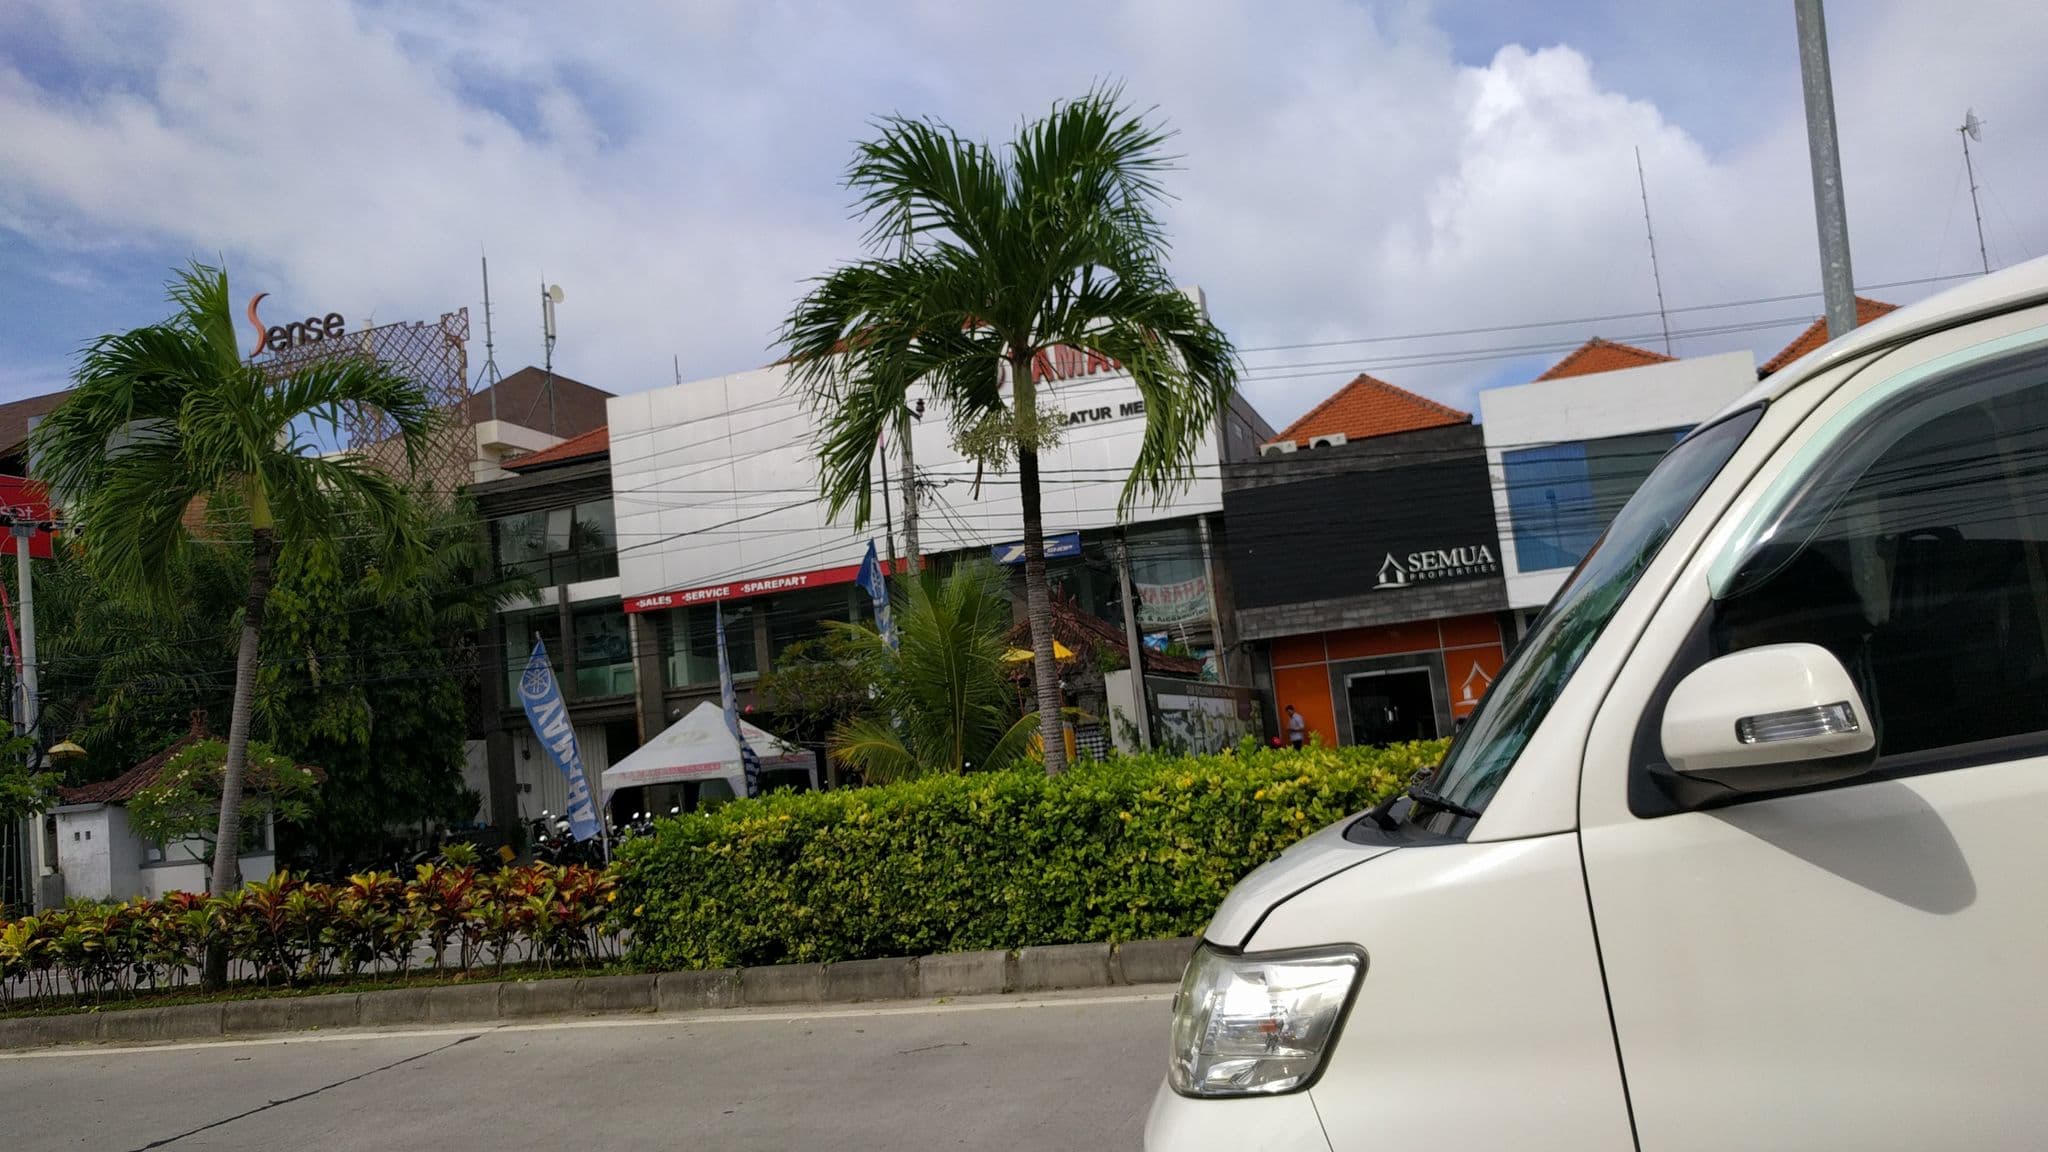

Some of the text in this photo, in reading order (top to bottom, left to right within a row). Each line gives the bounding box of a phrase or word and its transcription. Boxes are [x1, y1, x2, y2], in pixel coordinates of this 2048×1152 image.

[247, 292, 345, 358] Sense
[1407, 544, 1495, 573] SEMUA
[1409, 563, 1498, 580] PROPERTIES
